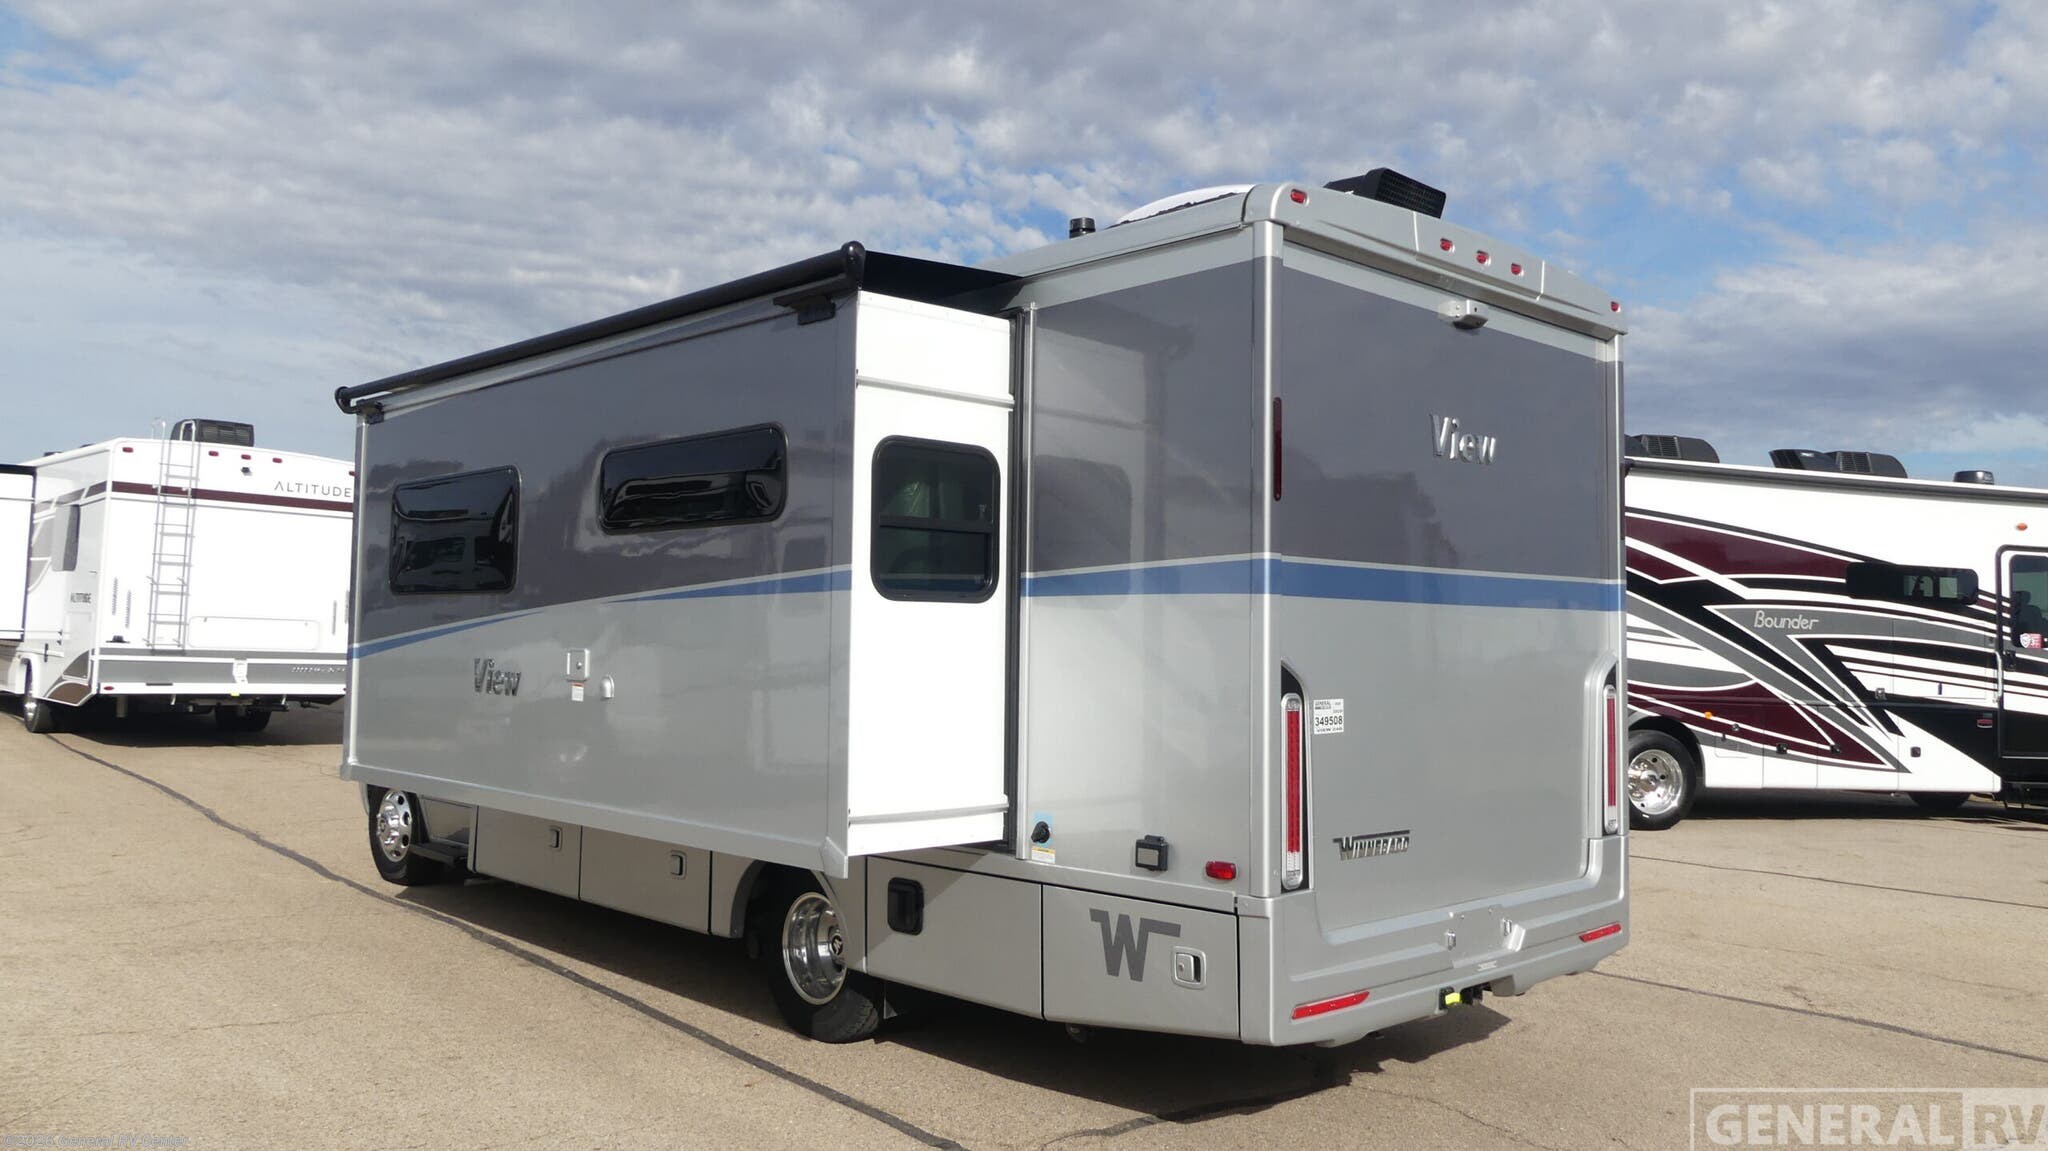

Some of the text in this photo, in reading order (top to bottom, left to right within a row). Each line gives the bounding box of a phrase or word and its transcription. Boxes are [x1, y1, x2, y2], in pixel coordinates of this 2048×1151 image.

[1429, 413, 1496, 464] View
[274, 481, 352, 498] ALTITUDE
[1753, 609, 1819, 630] Bounder
[474, 658, 522, 697] View
[1314, 715, 1343, 727] 349508
[1089, 907, 1182, 982] W
